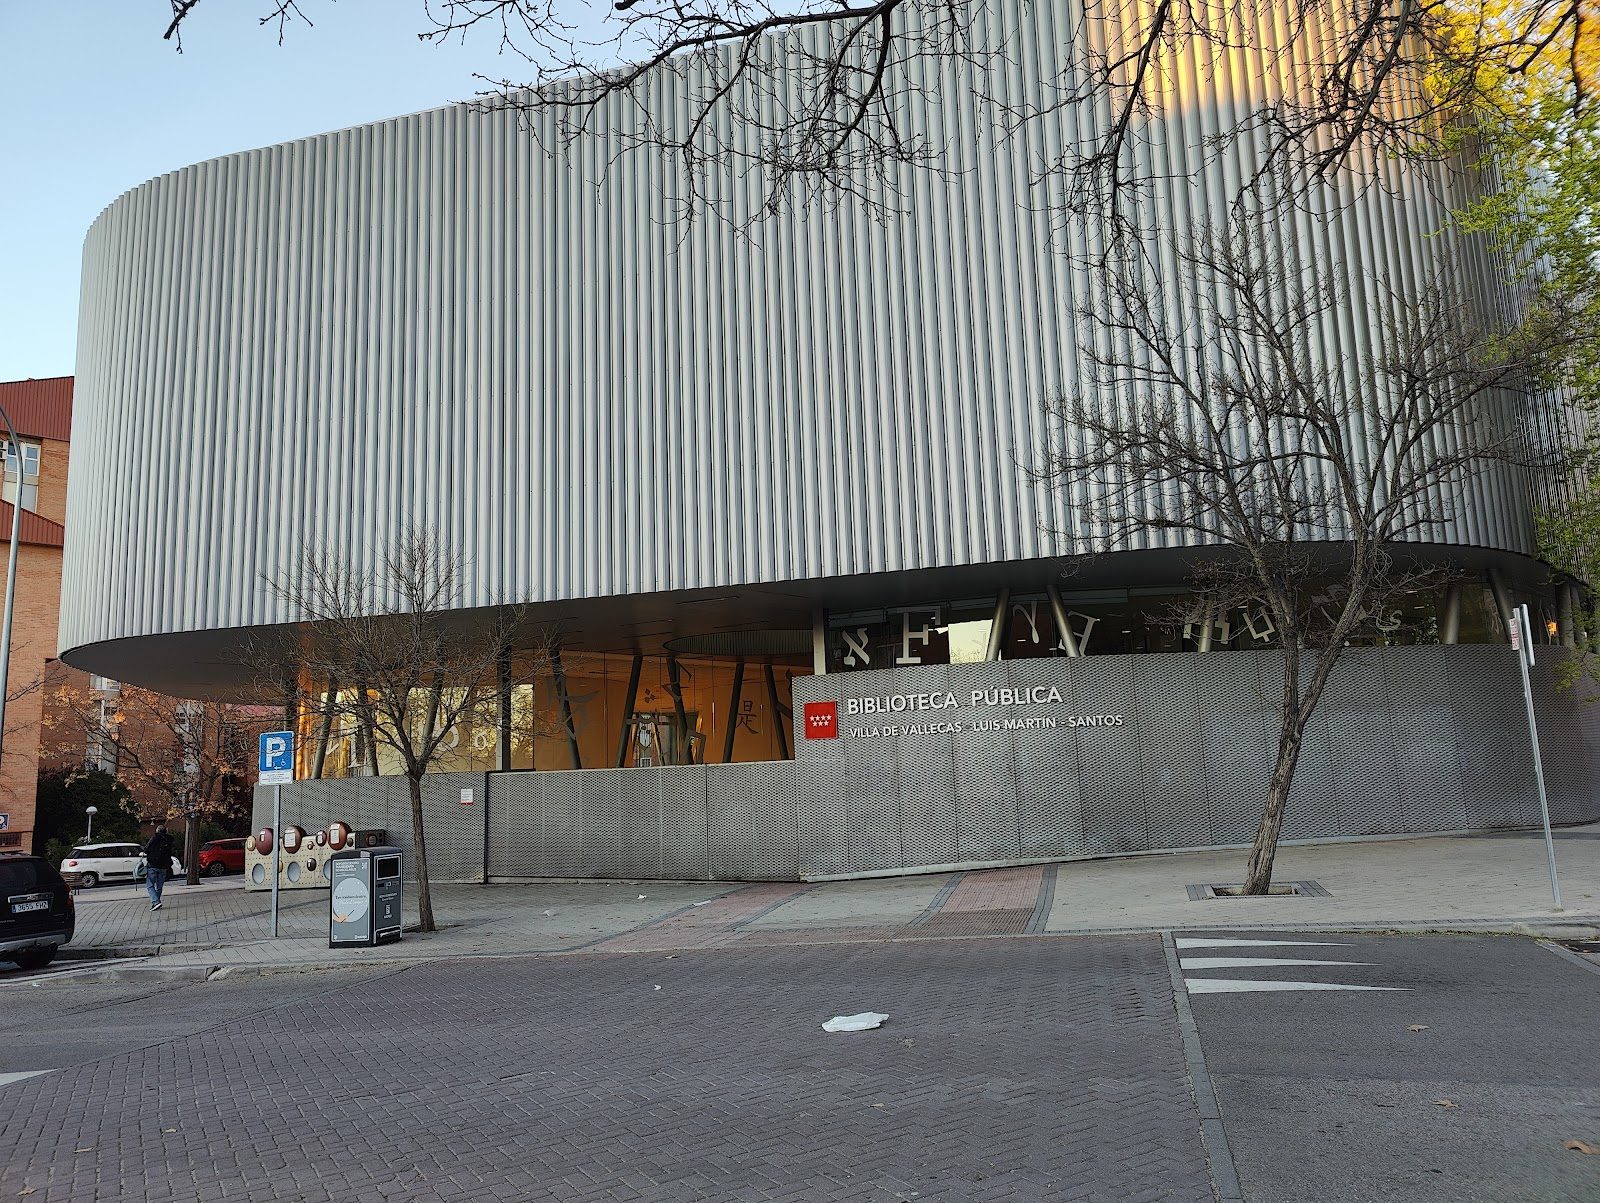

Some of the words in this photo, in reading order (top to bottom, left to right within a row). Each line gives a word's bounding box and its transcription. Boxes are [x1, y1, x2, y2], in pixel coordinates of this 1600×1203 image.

[847, 691, 960, 715] BIBLIOTECA
[971, 685, 1064, 707] PÚBLICA
[849, 726, 880, 738] VILLA
[883, 726, 899, 737] DE
[902, 721, 963, 736] VALLECAS
[973, 719, 1001, 732] LUIS
[1004, 715, 1057, 730] MARTÍN
[1068, 714, 1123, 728] SANTOS
[265, 736, 286, 768] P
